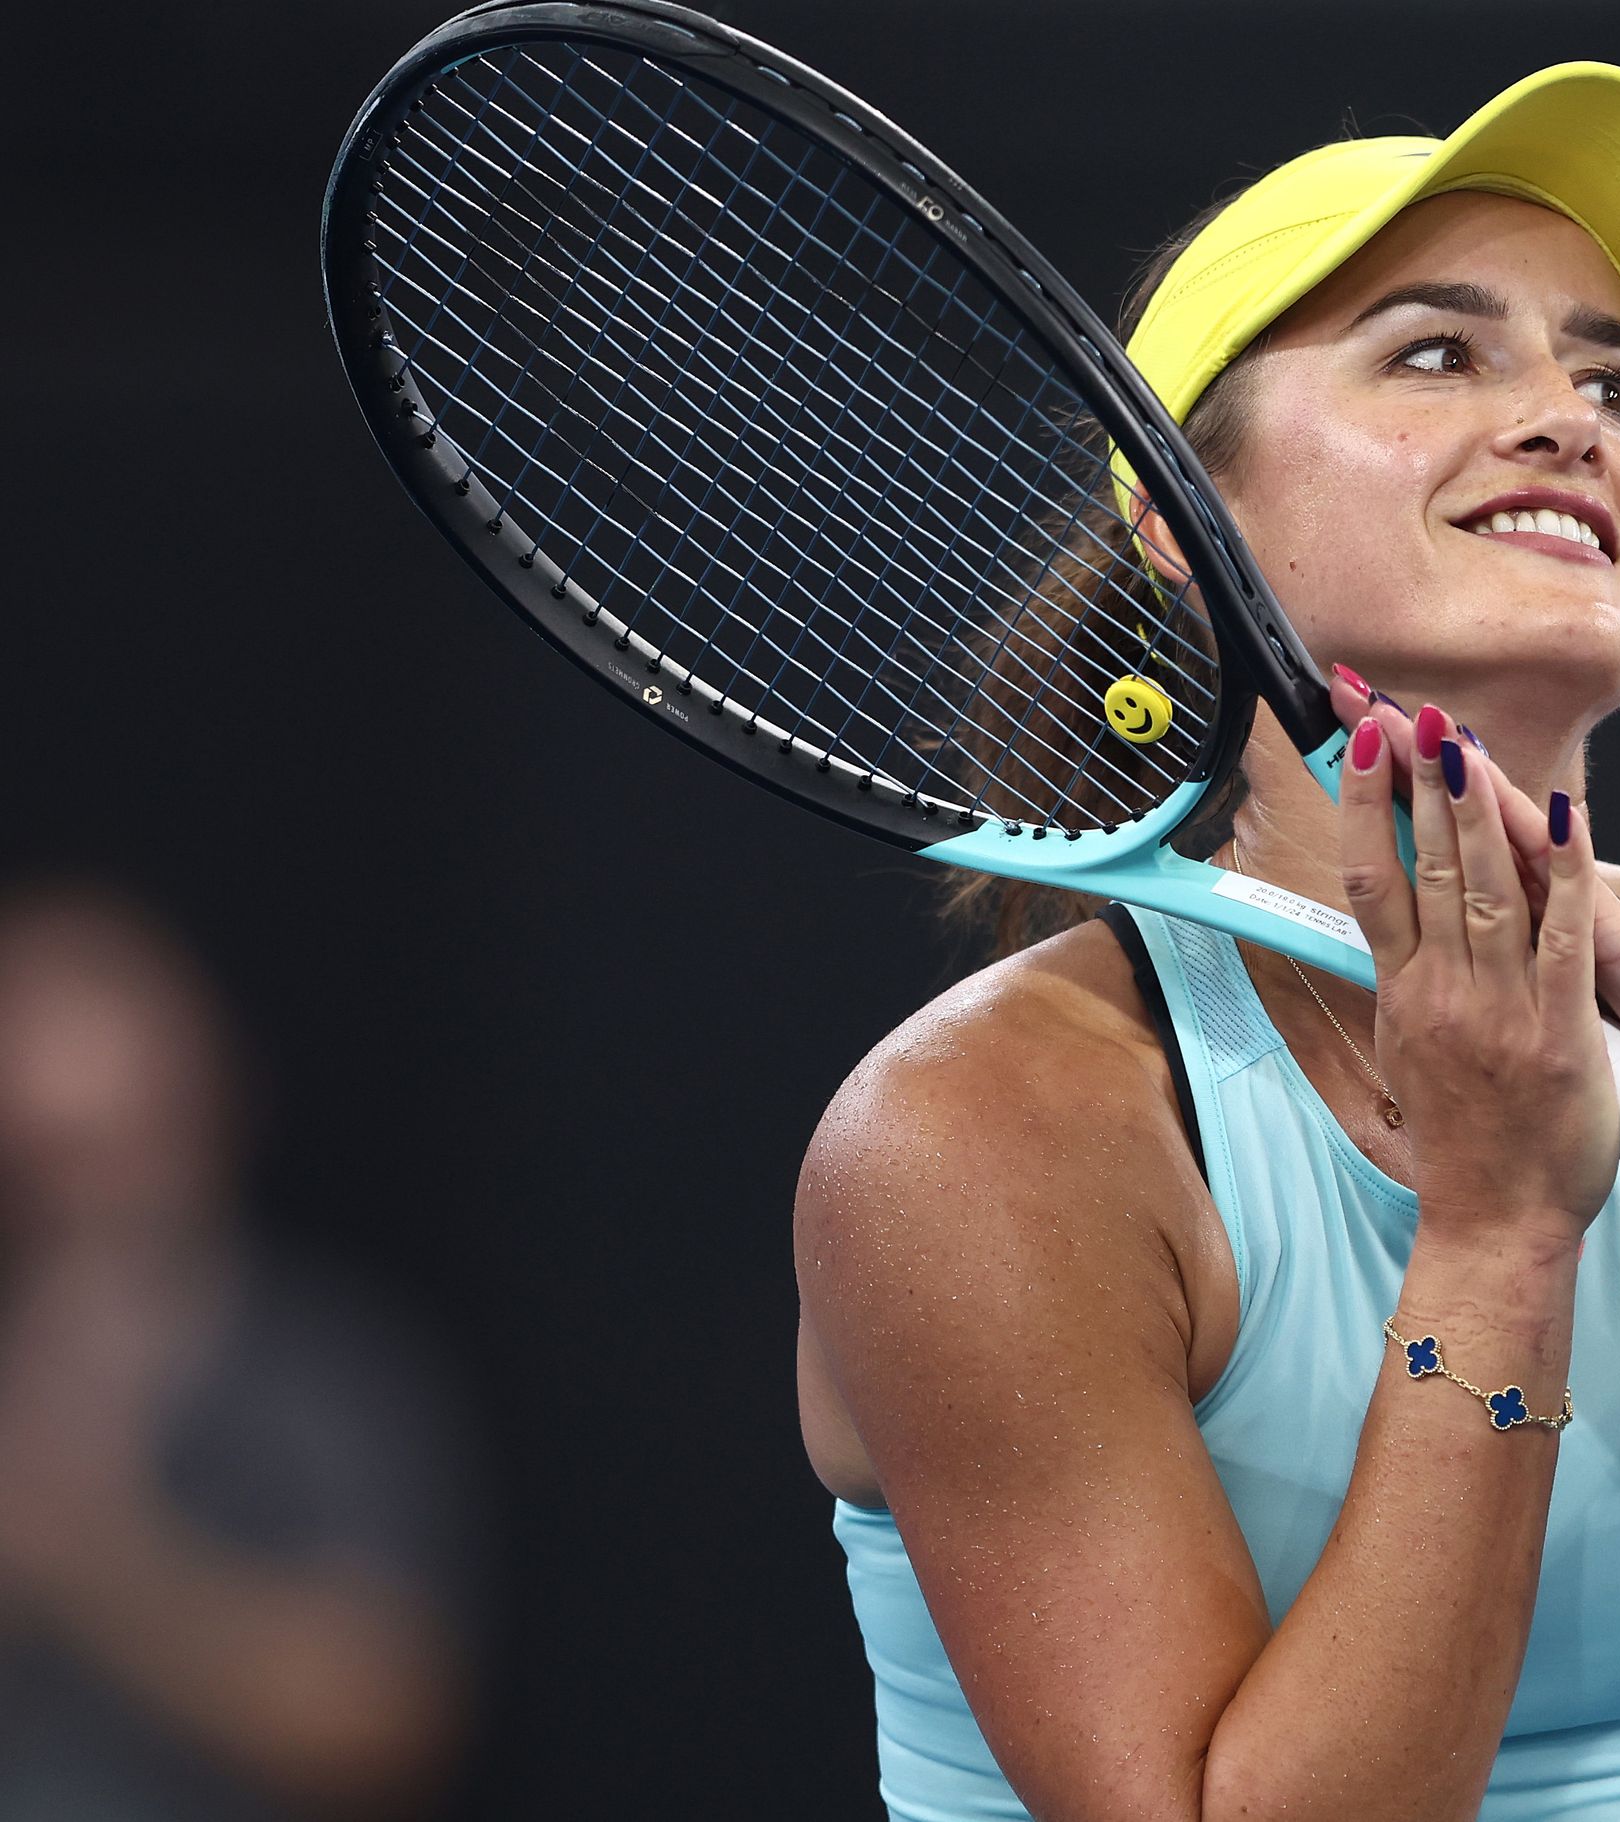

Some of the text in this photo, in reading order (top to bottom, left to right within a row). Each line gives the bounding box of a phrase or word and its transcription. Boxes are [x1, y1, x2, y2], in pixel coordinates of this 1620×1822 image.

[666, 702, 689, 722] POWER
[1326, 745, 1347, 769] HE
[1274, 902, 1301, 917] 1/1/24
[1297, 902, 1307, 910] kg
[1305, 914, 1330, 928] TENNIS
